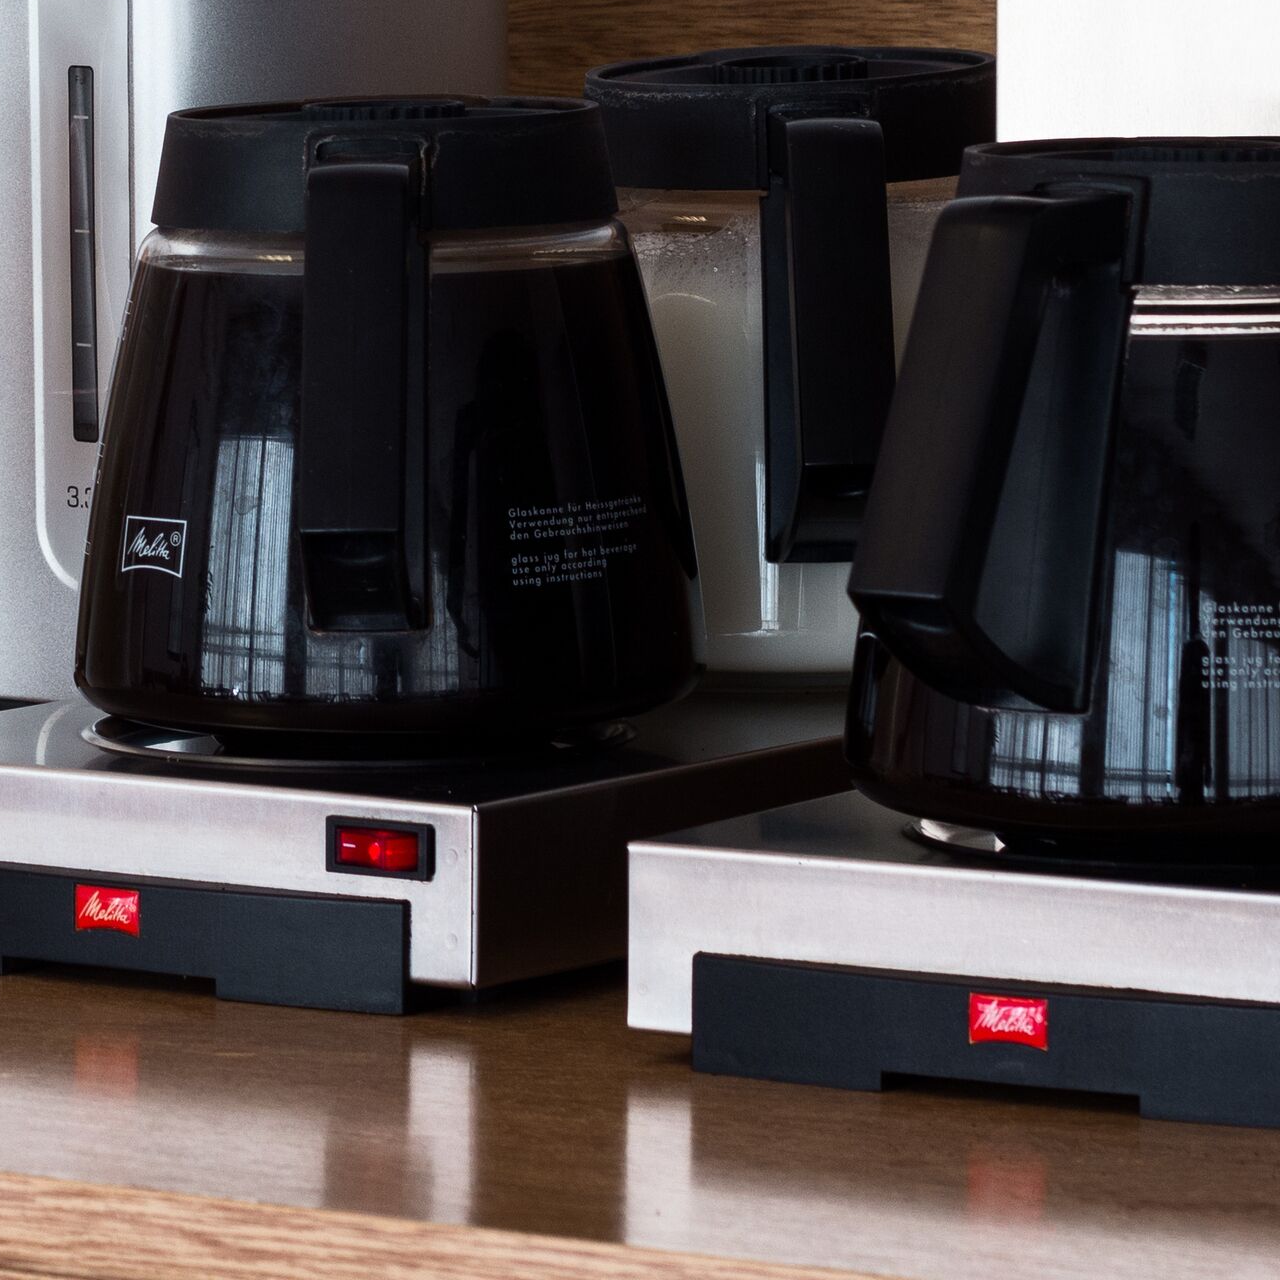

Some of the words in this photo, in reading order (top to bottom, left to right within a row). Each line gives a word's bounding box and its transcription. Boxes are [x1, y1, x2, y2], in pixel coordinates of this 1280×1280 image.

[508, 505, 564, 518] Glaskanne
[567, 502, 581, 513] für
[509, 516, 574, 529] Verwendung
[577, 514, 593, 524] nur
[509, 530, 530, 541] den
[534, 521, 630, 539] Gebrauchshinweisen
[511, 553, 540, 566] glass
[543, 551, 560, 565] jug
[563, 548, 578, 560] for
[581, 546, 597, 558] hot
[599, 543, 638, 556] beverage
[512, 565, 530, 575] use
[534, 560, 557, 574] only
[561, 557, 608, 570] according
[512, 575, 542, 587] using
[546, 570, 603, 584] instructions
[1202, 601, 1273, 613] Glaskanne
[1201, 625, 1226, 638] den
[1242, 653, 1262, 667] jug
[1201, 667, 1224, 677] use
[1230, 664, 1258, 678] only
[1264, 668, 1280, 677] ac
[1201, 678, 1238, 691] using
[79, 890, 131, 924] Melitta
